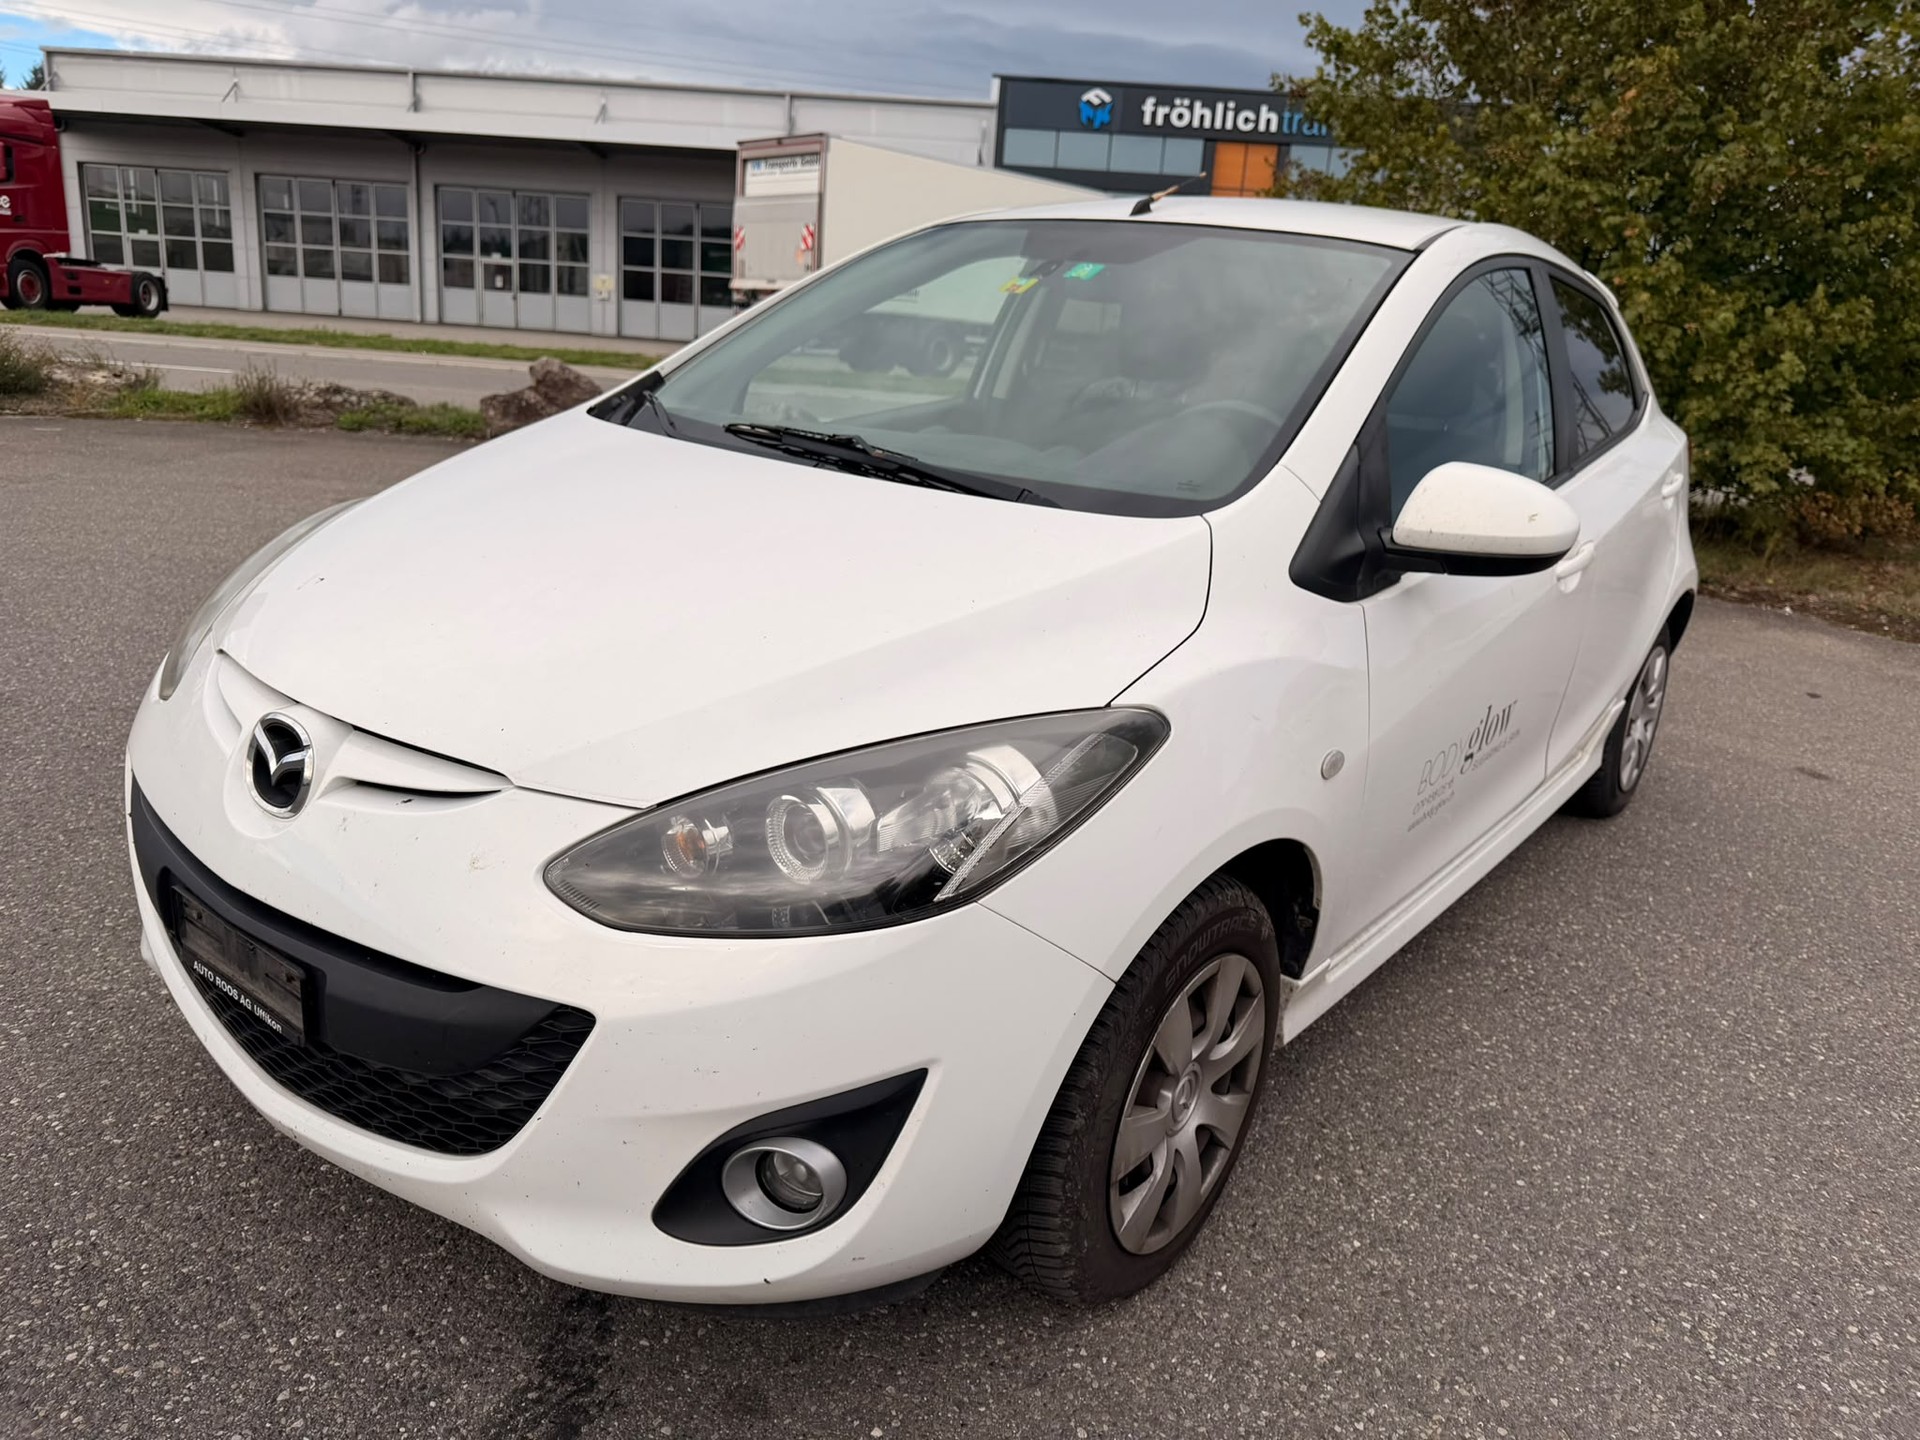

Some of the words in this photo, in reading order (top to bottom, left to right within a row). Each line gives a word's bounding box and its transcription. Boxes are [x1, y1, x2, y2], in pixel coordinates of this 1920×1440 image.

[193, 960, 214, 982] AUTO
[215, 976, 239, 1001] ROOS
[239, 995, 252, 1011] AG
